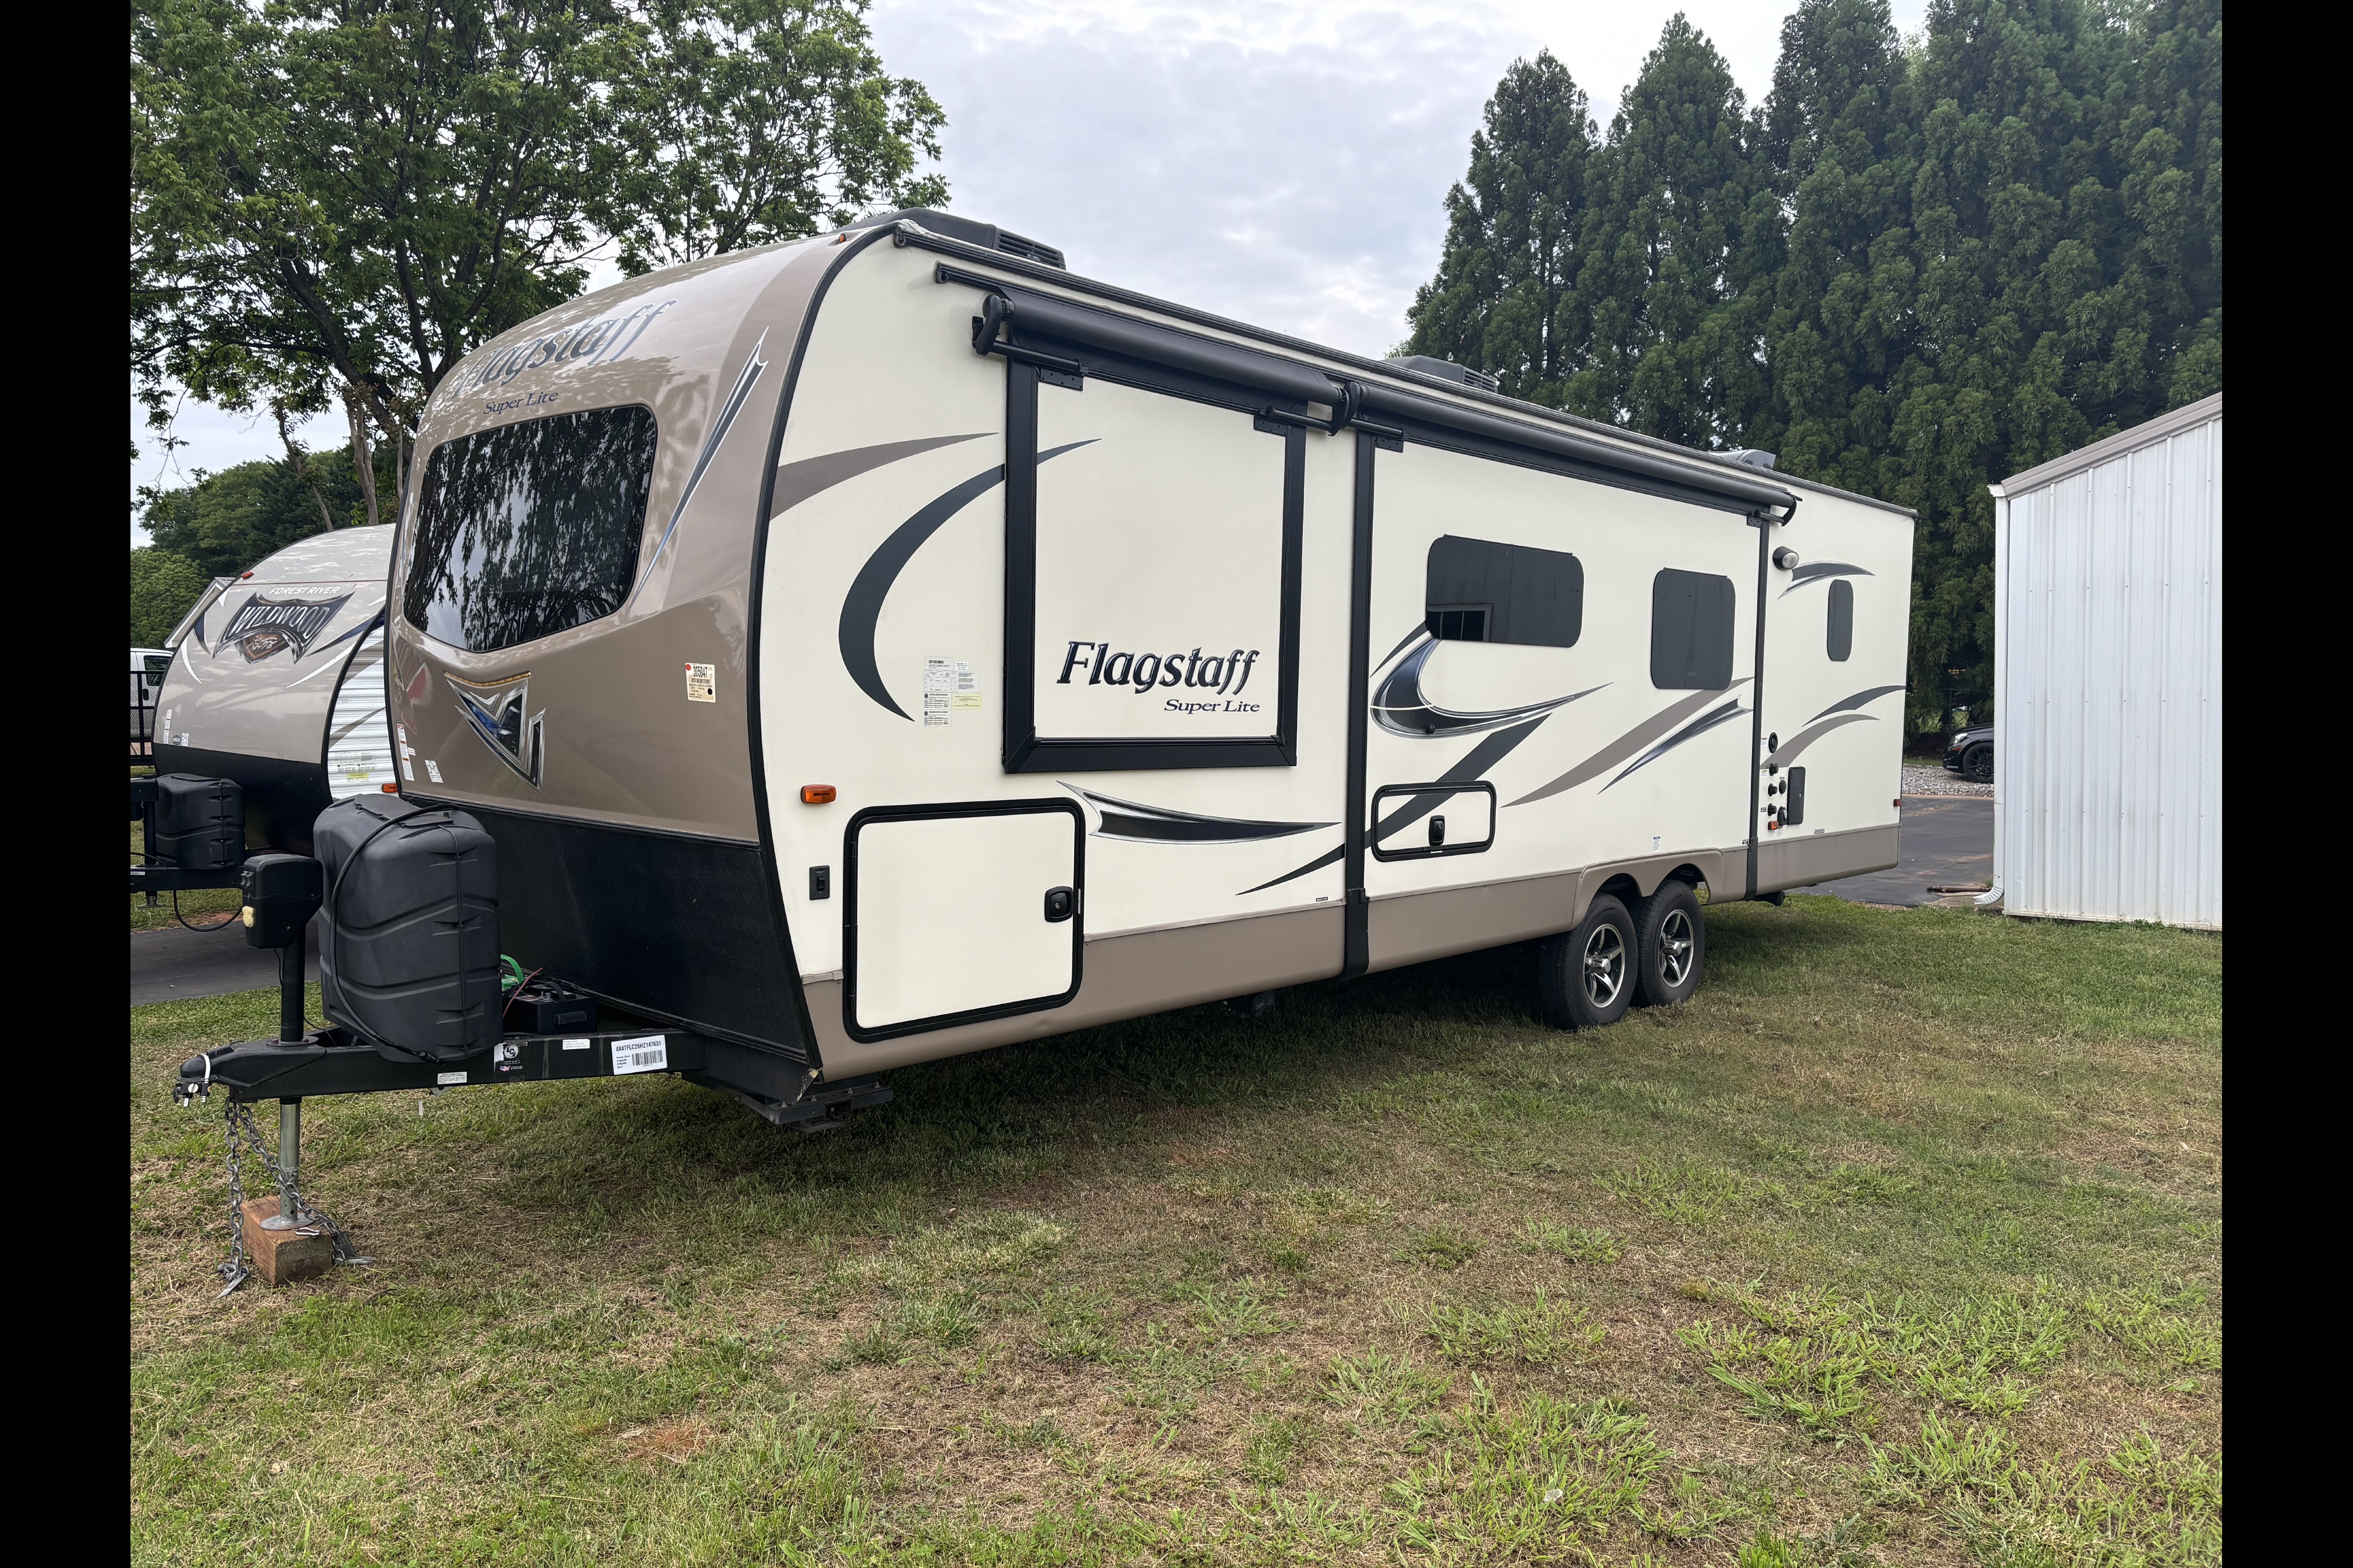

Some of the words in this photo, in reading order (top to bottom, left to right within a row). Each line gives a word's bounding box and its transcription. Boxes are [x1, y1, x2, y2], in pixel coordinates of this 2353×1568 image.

[450, 299, 678, 399] Flagstaff
[483, 398, 524, 414] Super
[525, 392, 559, 406] Lite
[228, 606, 330, 639] WILDWOOD
[693, 665, 708, 678] 305047
[1056, 640, 1261, 696] Flagstaff
[1164, 699, 1221, 715] Super
[1222, 700, 1261, 712] Lite
